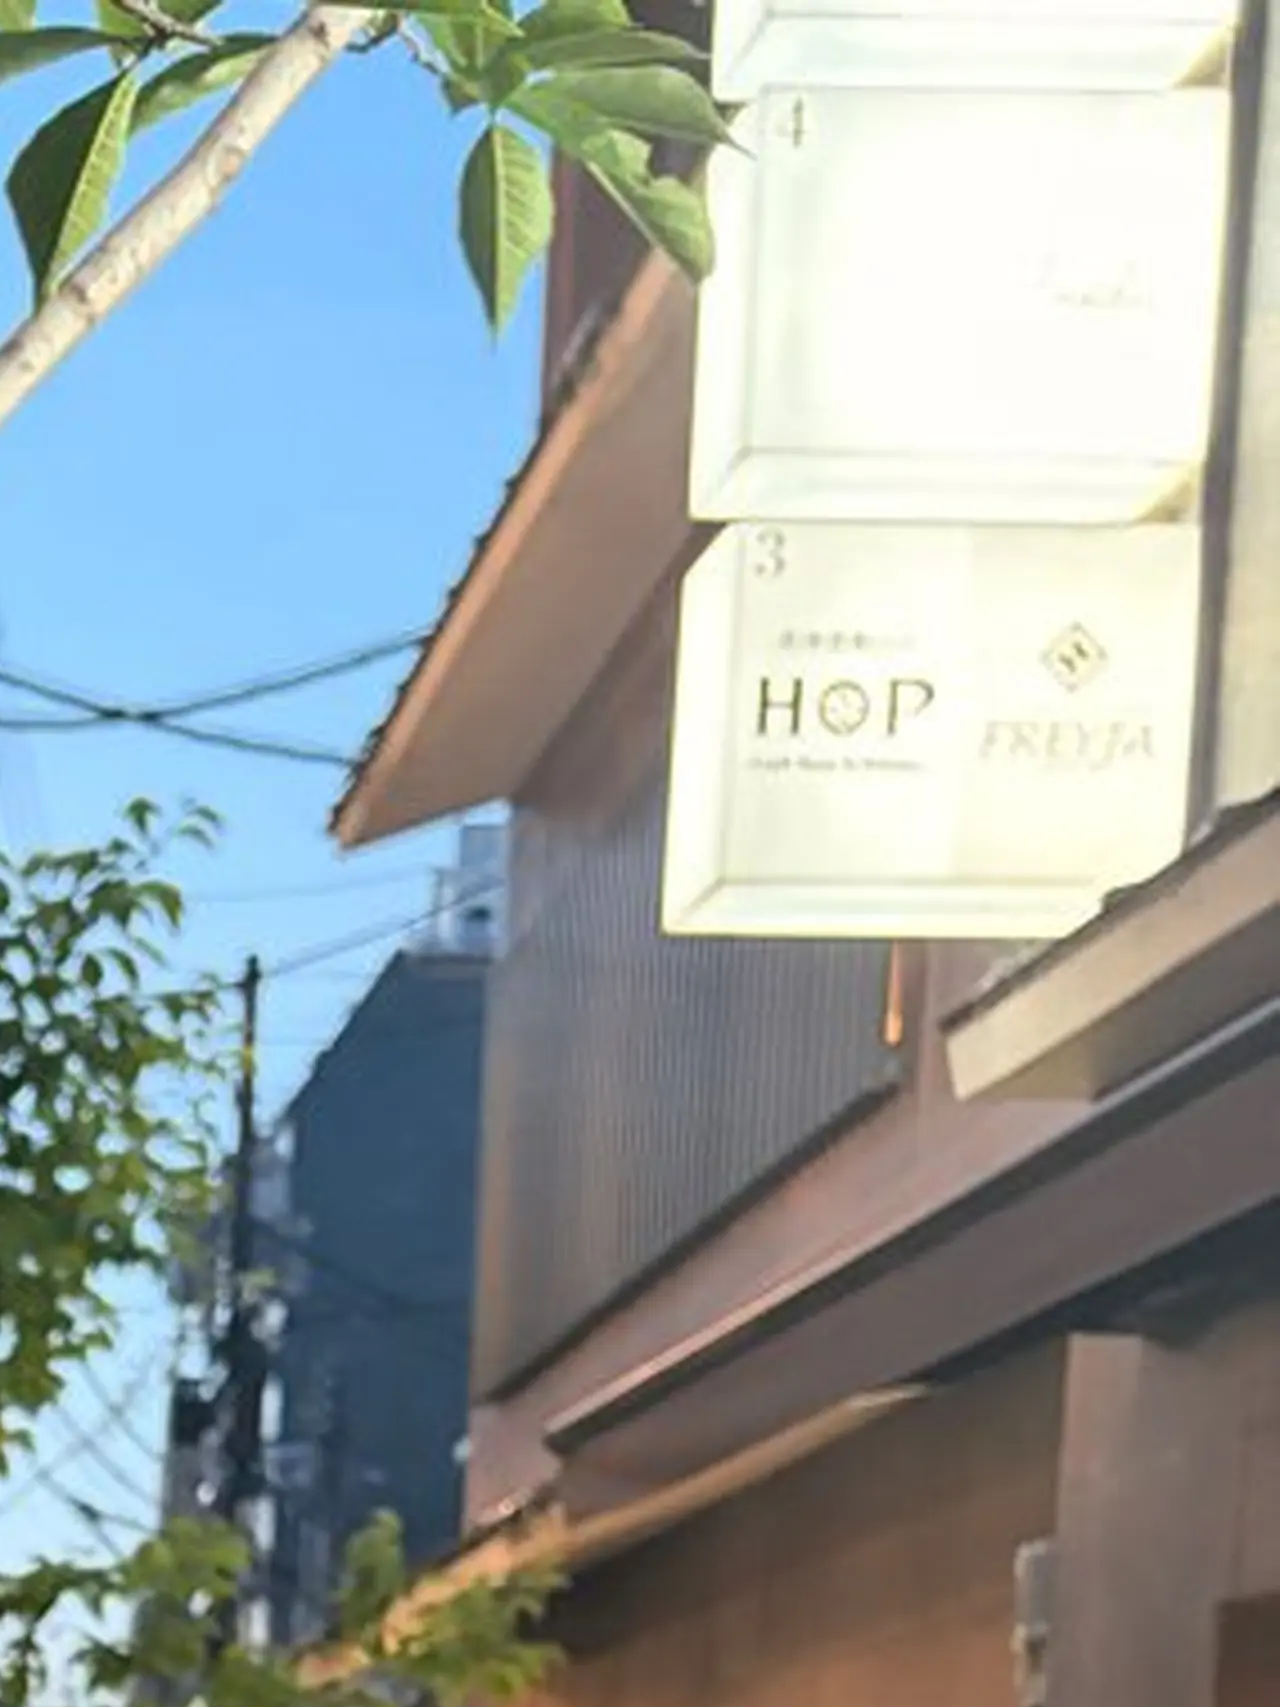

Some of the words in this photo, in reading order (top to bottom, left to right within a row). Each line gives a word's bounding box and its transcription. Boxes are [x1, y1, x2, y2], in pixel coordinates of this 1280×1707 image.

[775, 96, 807, 149] 4
[753, 526, 788, 579] 3
[756, 676, 937, 738] HOP
